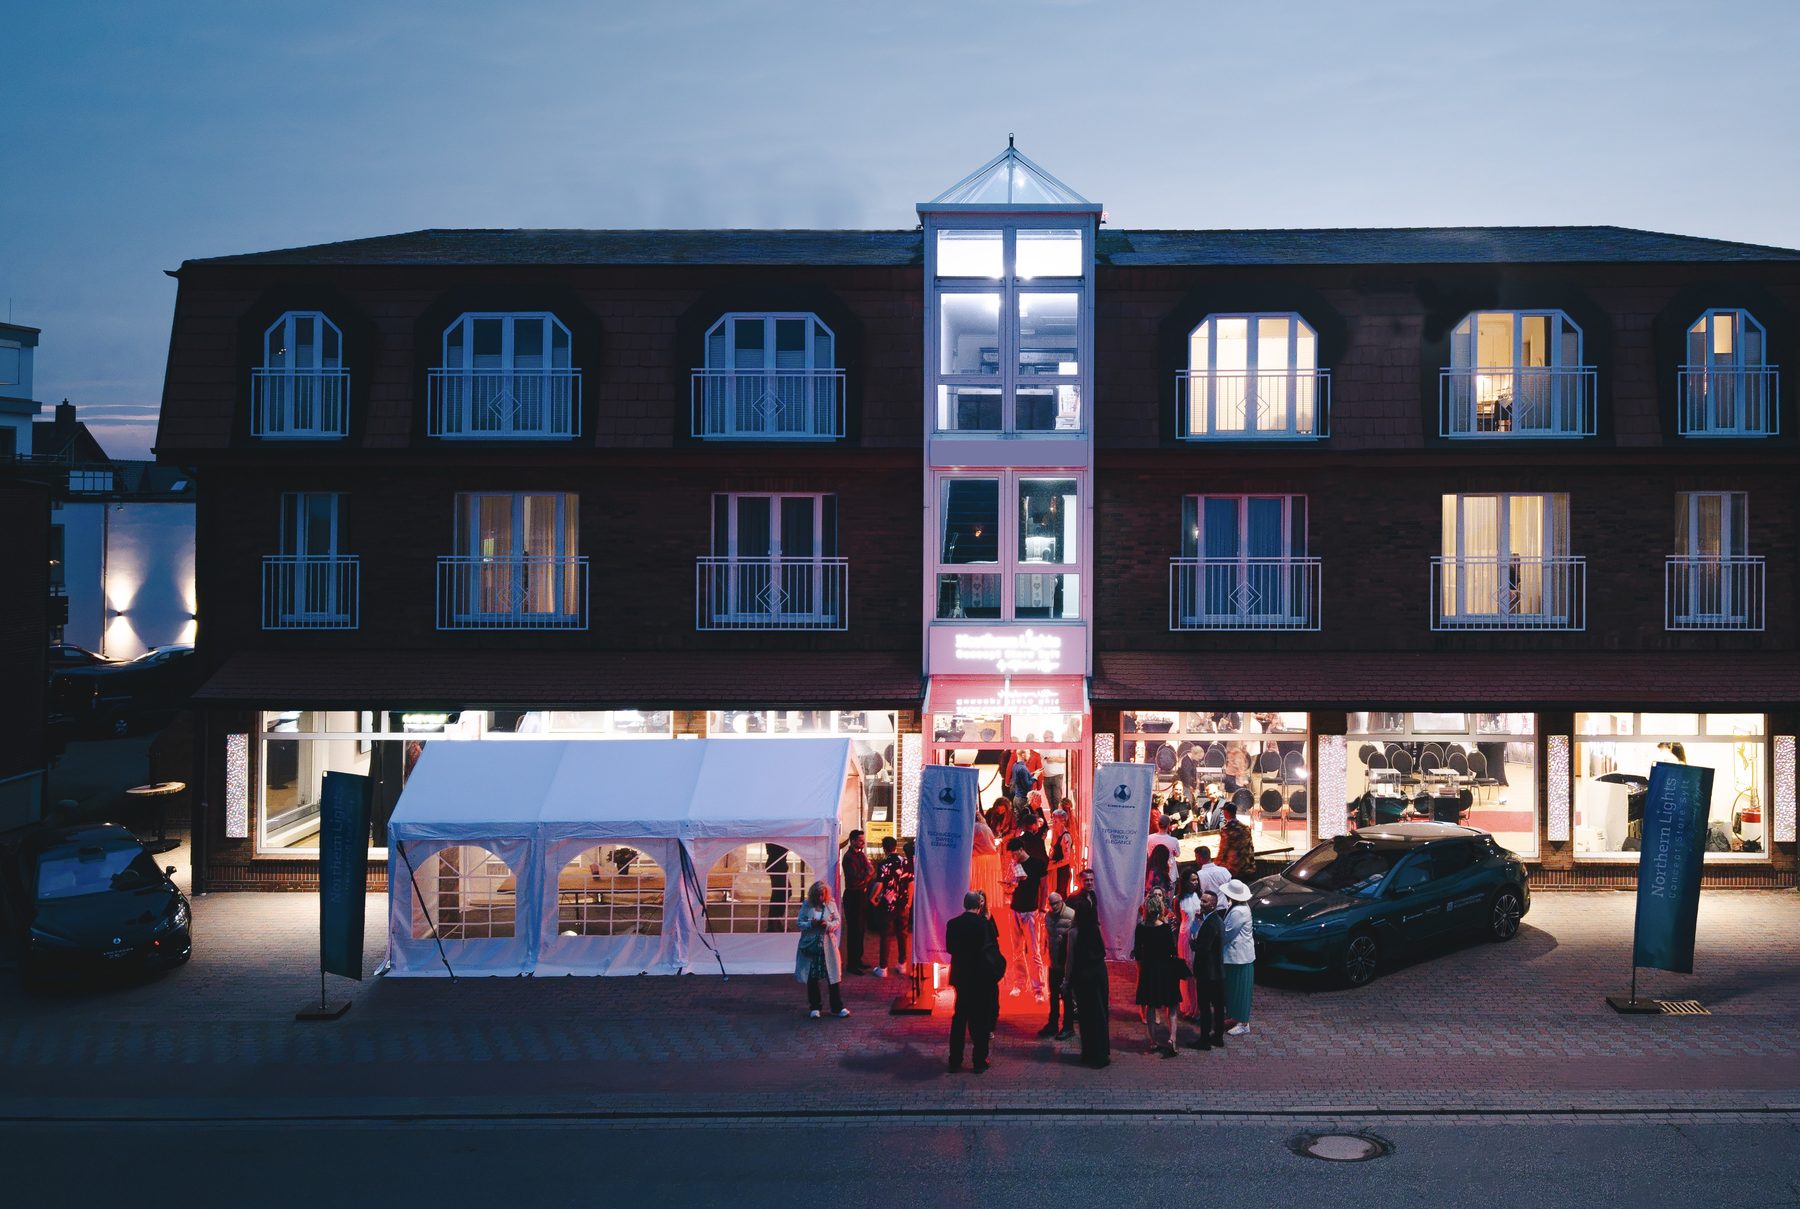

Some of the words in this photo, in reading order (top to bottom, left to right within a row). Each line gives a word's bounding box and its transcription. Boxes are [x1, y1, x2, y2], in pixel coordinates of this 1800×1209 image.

[1656, 778, 1678, 823] Lights
[1674, 808, 1687, 842] Store
[329, 835, 342, 904] Northern
[1650, 827, 1670, 898] Northern
